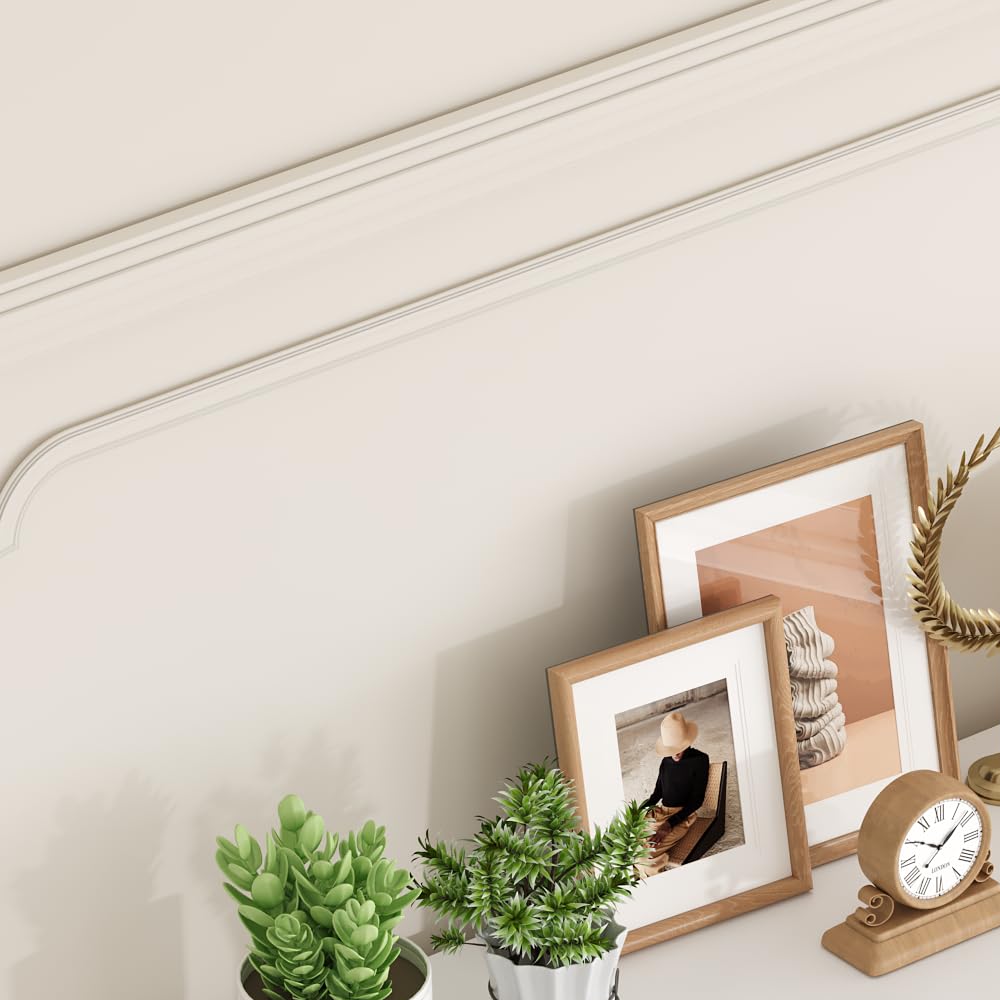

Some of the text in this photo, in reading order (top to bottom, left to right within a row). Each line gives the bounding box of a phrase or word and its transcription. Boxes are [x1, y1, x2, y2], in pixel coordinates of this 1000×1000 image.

[934, 804, 945, 823] XII
[960, 811, 975, 828] II
[917, 816, 931, 832] XI
[963, 830, 979, 843] III
[931, 861, 951, 874] LONDON
